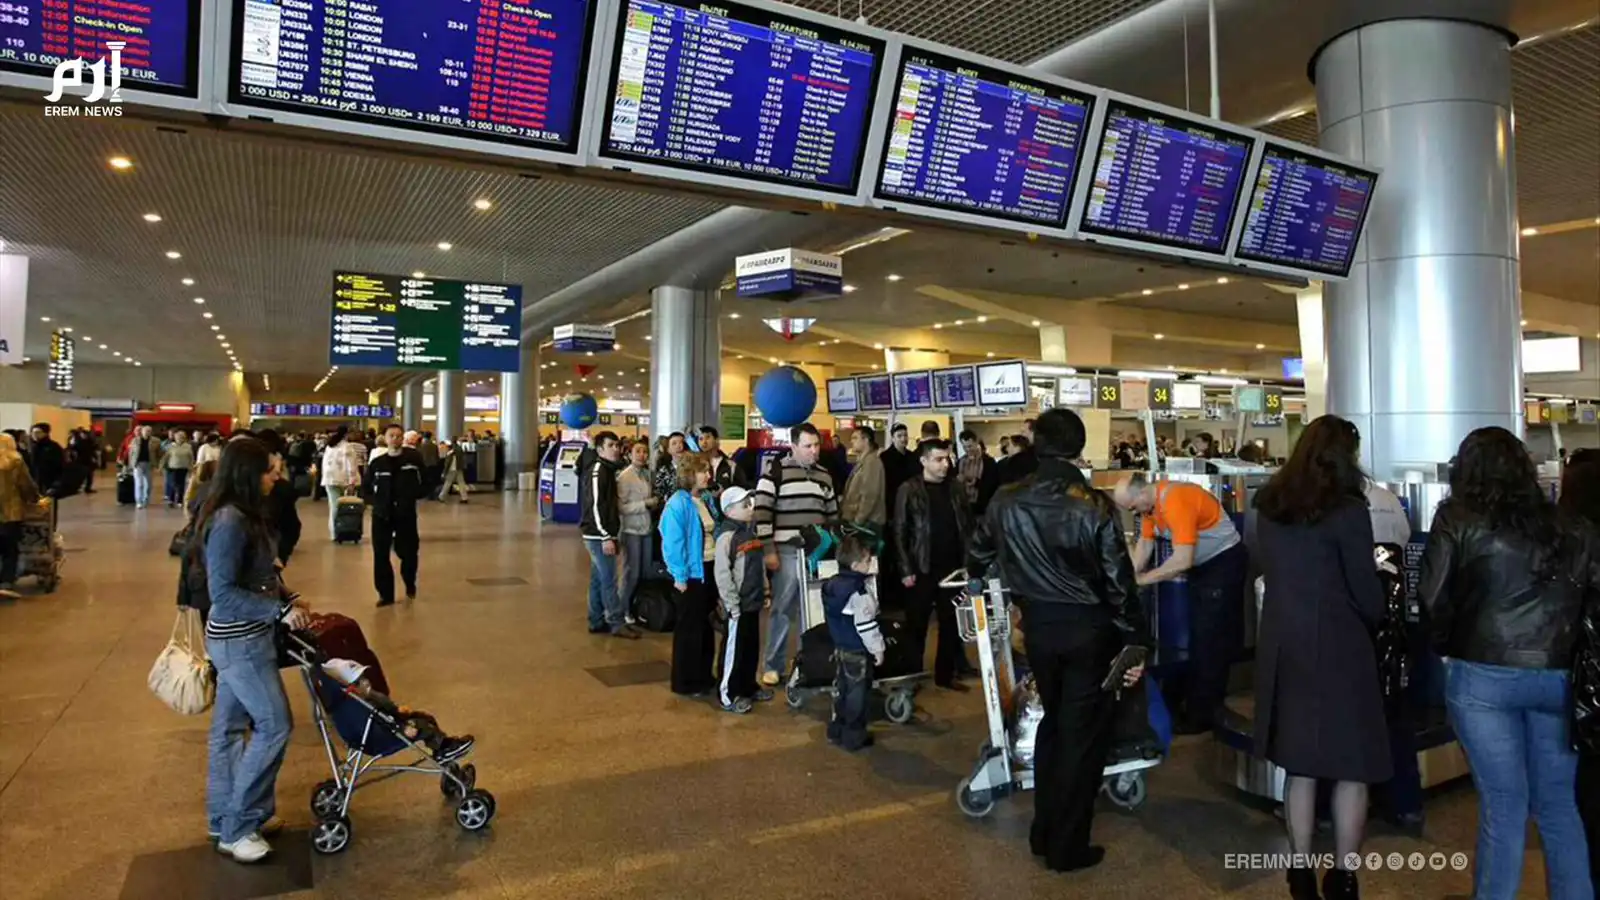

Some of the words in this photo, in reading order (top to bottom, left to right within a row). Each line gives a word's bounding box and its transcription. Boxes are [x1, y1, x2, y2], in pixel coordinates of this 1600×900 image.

[350, 2, 378, 13] RABAT
[502, 3, 532, 17] Check-in
[534, 9, 552, 19] Open
[74, 15, 116, 30] Check-in
[118, 23, 143, 34] Open
[349, 12, 383, 24] LONDON
[348, 21, 382, 34] LONDON
[770, 21, 819, 39] DEPARTURES
[6, 37, 24, 48] 110
[347, 31, 381, 43] LONDON
[361, 43, 416, 60] PETERSBURG
[24, 52, 37, 61] 10
[40, 54, 59, 66] 000
[132, 68, 159, 80] EUR.
[345, 70, 374, 82] VIENNA
[343, 80, 373, 92] VIENNA
[268, 89, 290, 100] USD
[320, 97, 337, 107] 444
[342, 90, 376, 102] ODESSA
[1102, 386, 1116, 401] 33
[1154, 388, 1168, 402] 34
[1266, 394, 1279, 408] 35
